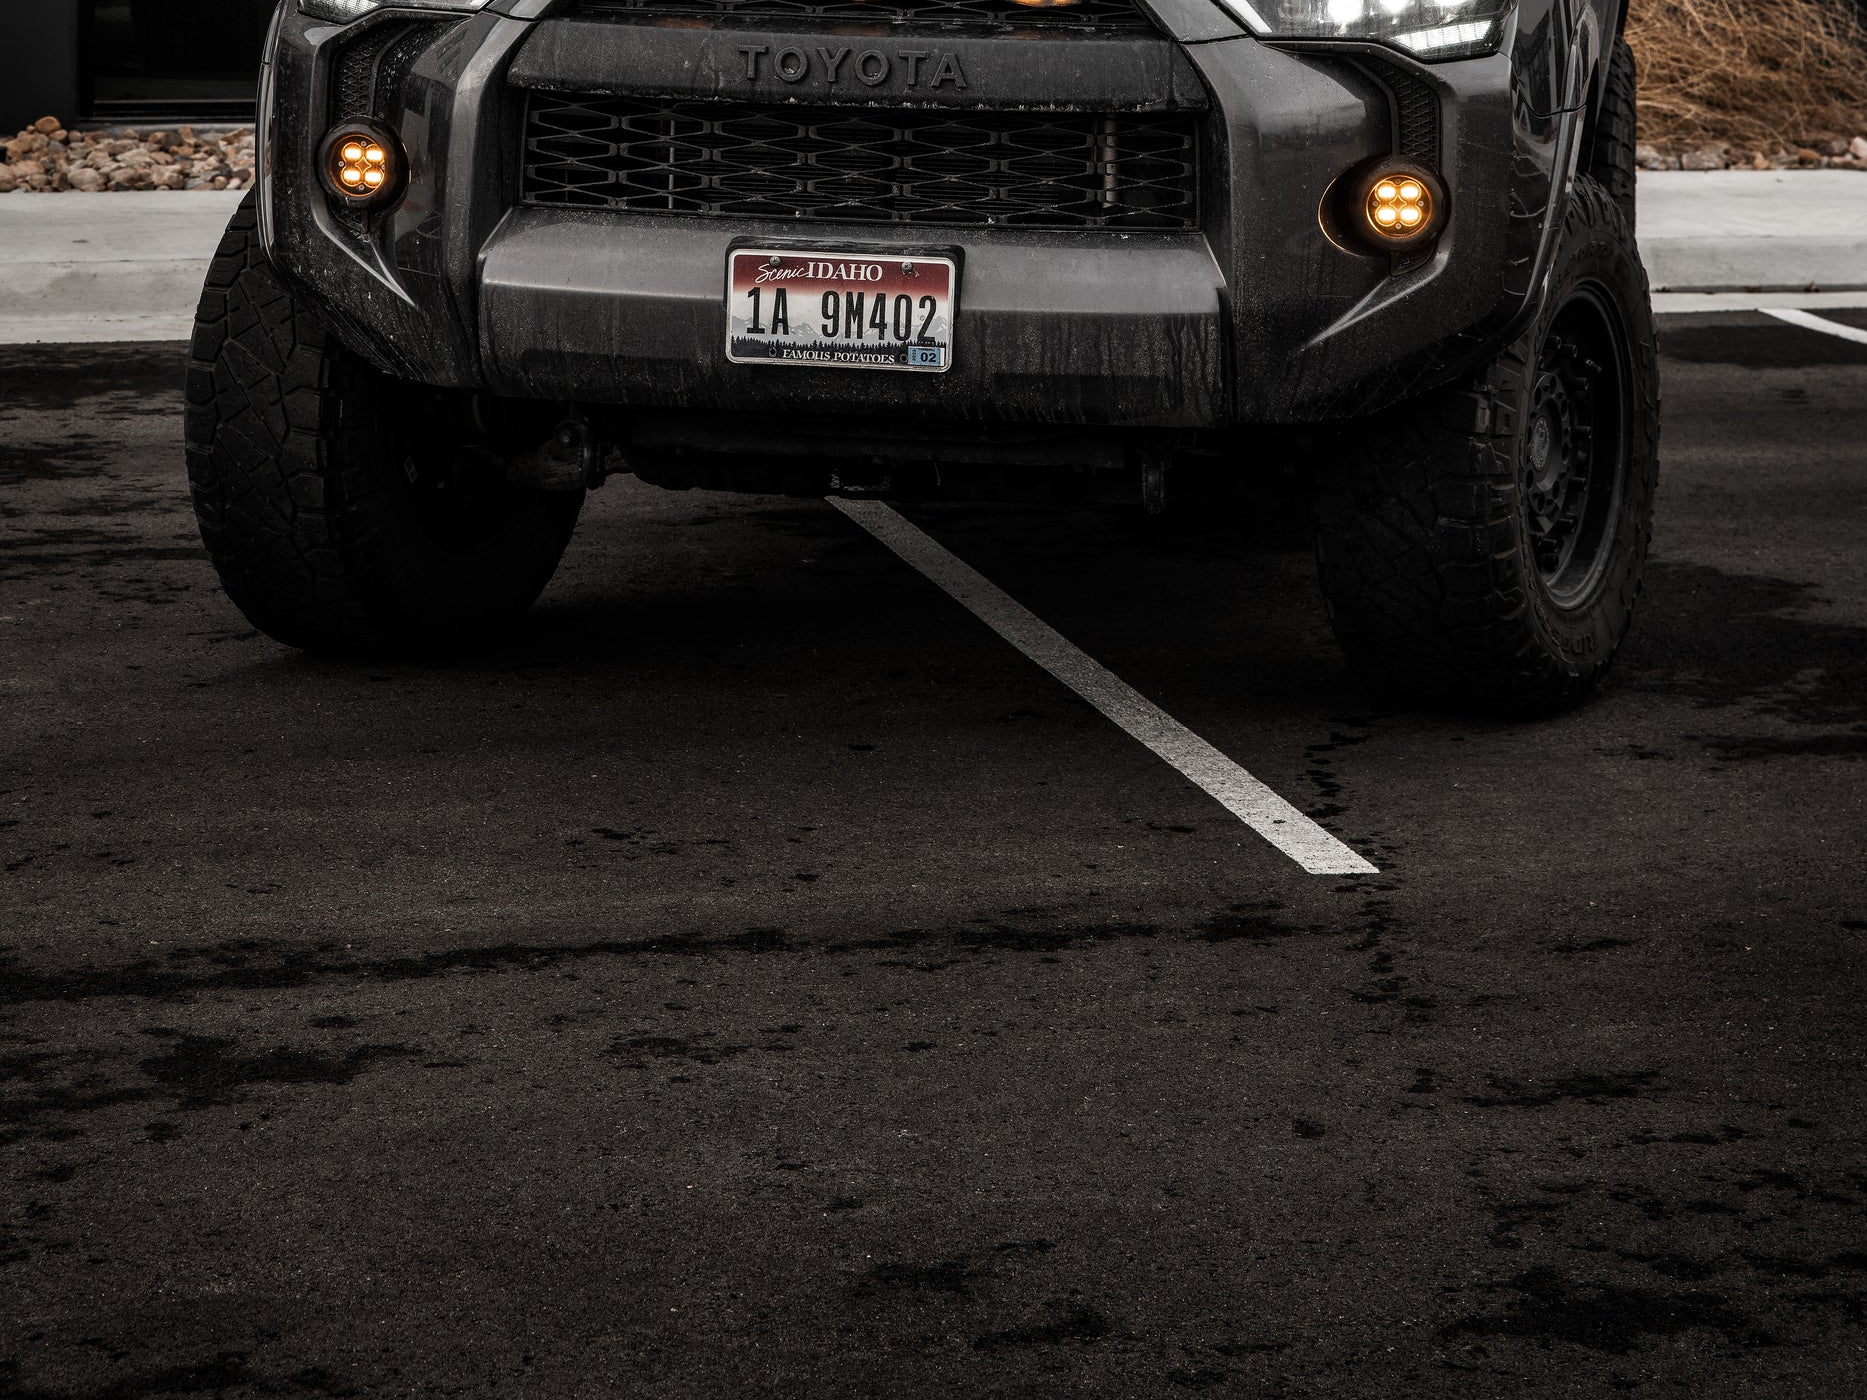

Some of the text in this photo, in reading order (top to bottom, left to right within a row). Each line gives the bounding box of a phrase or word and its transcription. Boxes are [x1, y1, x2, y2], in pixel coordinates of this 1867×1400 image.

[738, 44, 968, 90] TOYOTA
[755, 262, 883, 284] Scenic IDAHO
[746, 286, 937, 344] 1A 9M402
[782, 349, 895, 364] FAMOUS POTATOES
[920, 352, 937, 363] 02
